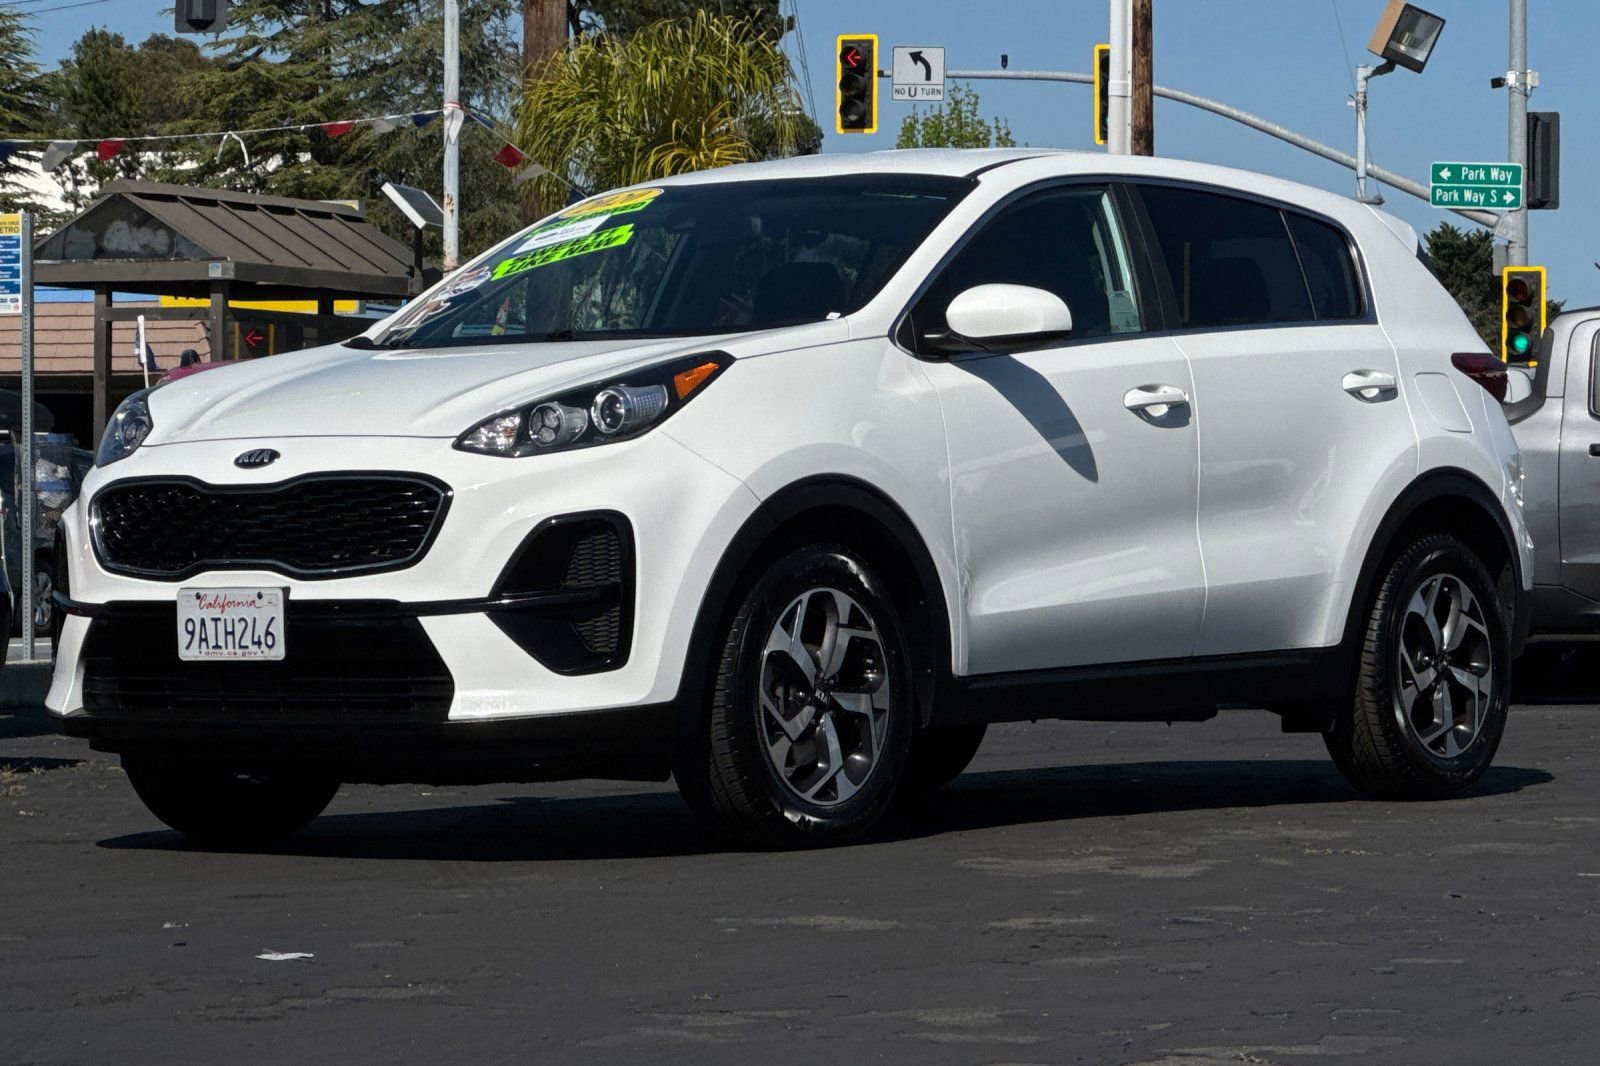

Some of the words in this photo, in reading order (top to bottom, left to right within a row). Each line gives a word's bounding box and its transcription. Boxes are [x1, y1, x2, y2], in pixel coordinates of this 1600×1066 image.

[908, 87, 916, 97] U
[1461, 167, 1486, 180] Park
[1490, 167, 1513, 184] Way
[1436, 188, 1460, 202] Park
[1463, 189, 1485, 205] Way
[1490, 190, 1497, 203] S
[507, 252, 554, 274] LIKE
[561, 233, 622, 259] NEW
[238, 450, 271, 463] KIA
[199, 594, 257, 614] California
[185, 616, 276, 650] 9AIH246
